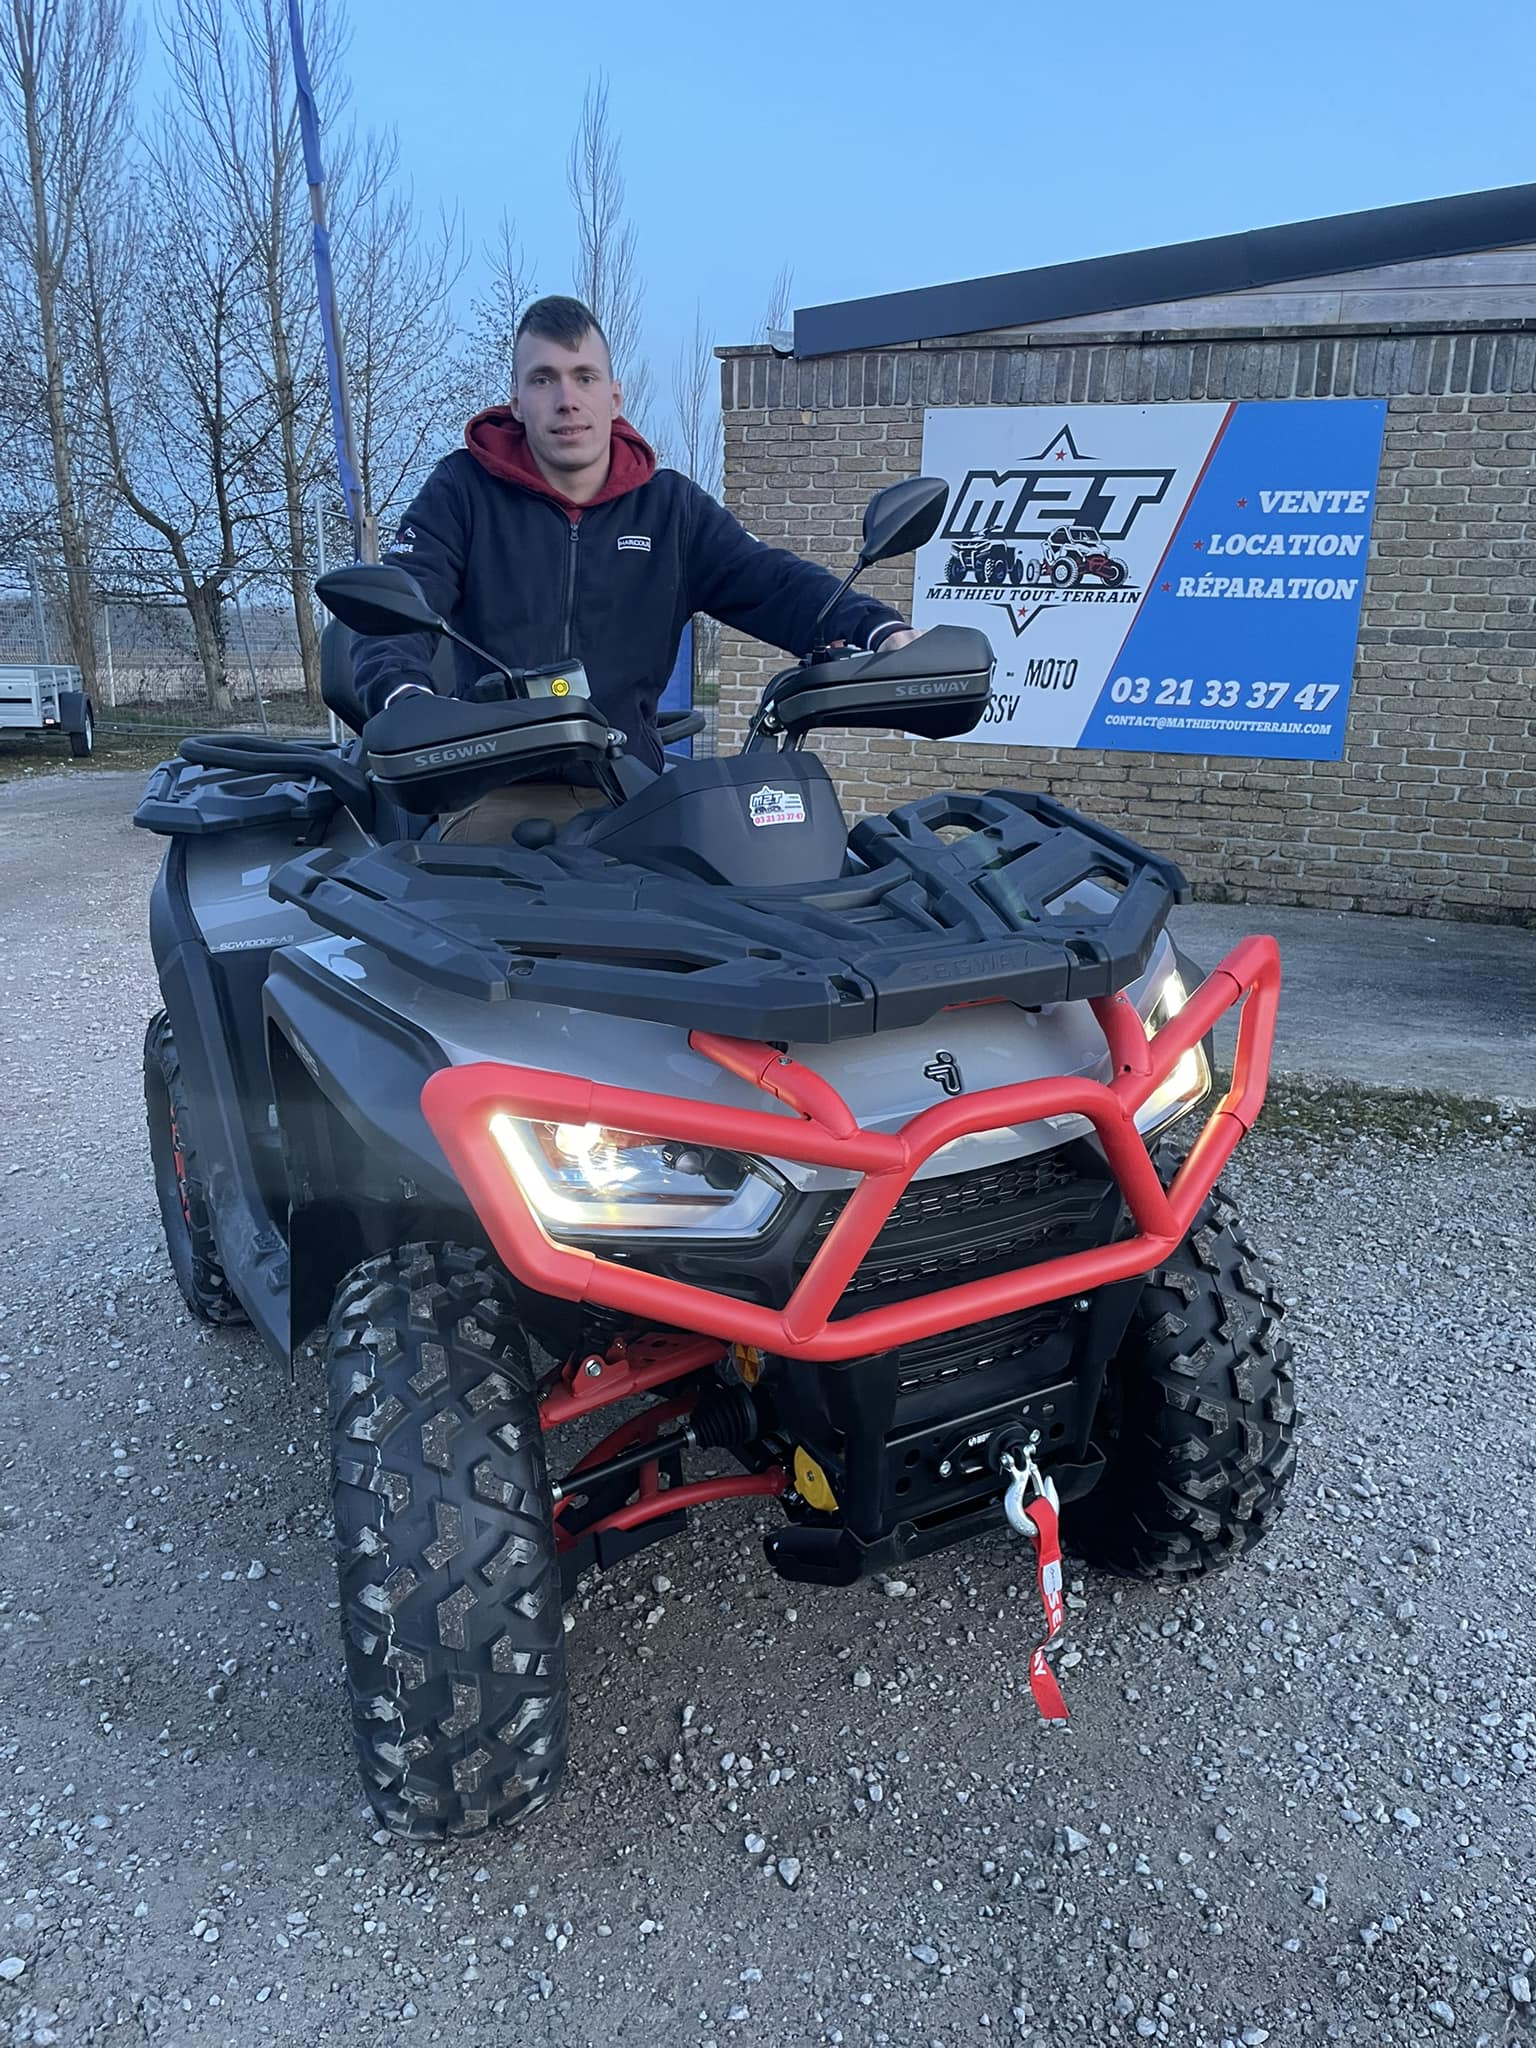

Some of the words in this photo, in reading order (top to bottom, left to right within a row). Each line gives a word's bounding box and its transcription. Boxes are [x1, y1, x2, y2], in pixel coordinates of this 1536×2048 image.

[940, 469, 1177, 540] M2T
[1259, 490, 1370, 514] VENTE
[1207, 534, 1364, 557] LOCATION
[926, 588, 1005, 601] MATHIEU
[1010, 590, 1142, 604] TOUT-TERRAIN
[1176, 571, 1358, 600] RÉPARATION
[1024, 658, 1078, 690] MOTO
[895, 680, 969, 697] SEGWAY
[1111, 677, 1151, 704] 03
[1155, 678, 1194, 706] 21
[1200, 680, 1241, 708] 33
[1246, 681, 1290, 709] 37
[1294, 683, 1340, 712] 47
[983, 694, 1020, 723] SSV
[1105, 715, 1331, 735] CONTACT@MATHIEUTOUTTERRAIN.COM
[414, 741, 497, 767] SEGWAY
